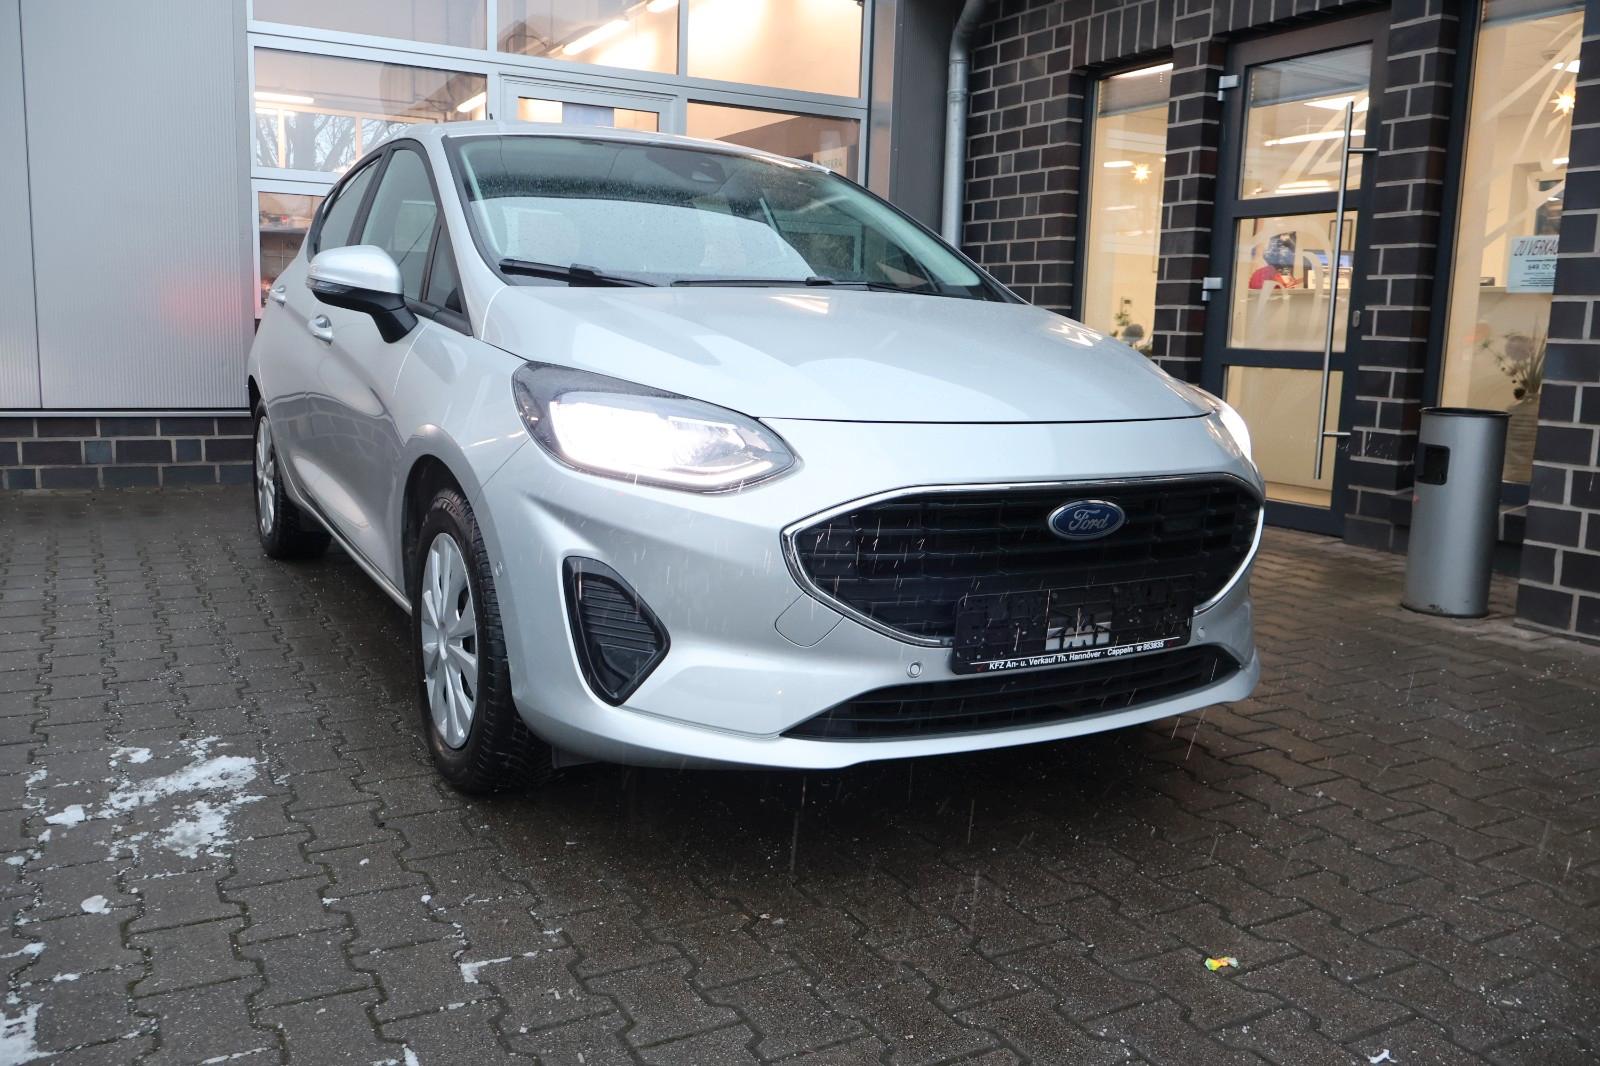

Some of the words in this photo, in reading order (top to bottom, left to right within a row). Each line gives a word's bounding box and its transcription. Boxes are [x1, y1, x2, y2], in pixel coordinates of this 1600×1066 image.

[1068, 509, 1110, 530] Ford
[989, 661, 1005, 670] KFZ
[1005, 660, 1019, 669] An-
[1020, 659, 1027, 667] u.
[1029, 655, 1056, 666] Verkauf
[1057, 655, 1068, 663] Th.
[1107, 645, 1134, 656] Cappeln
